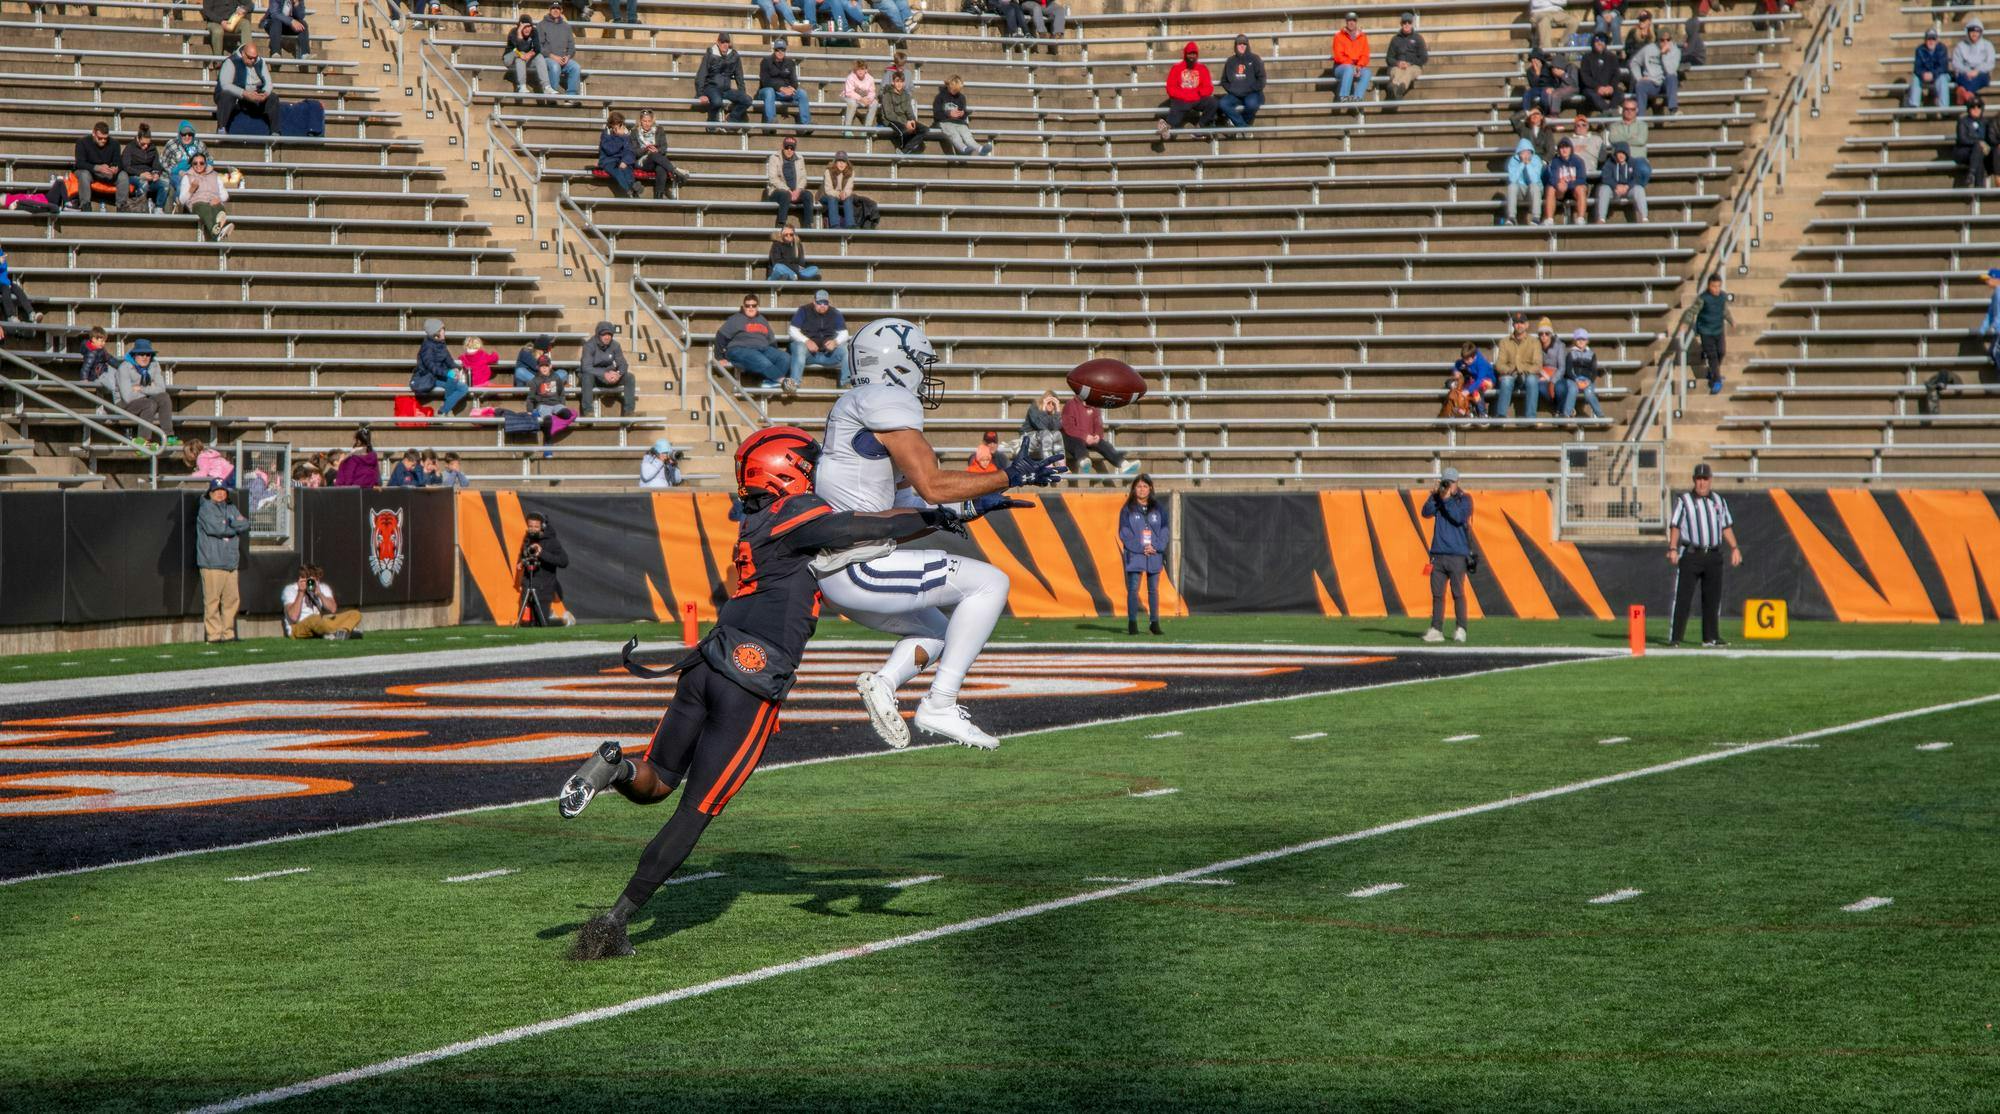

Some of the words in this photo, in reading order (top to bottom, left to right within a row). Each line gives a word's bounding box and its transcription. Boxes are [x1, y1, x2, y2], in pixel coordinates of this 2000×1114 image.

[885, 324, 914, 349] Y
[857, 377, 870, 385] 150
[686, 604, 694, 613] P
[1633, 609, 1640, 619] P
[1757, 602, 1775, 629] G
